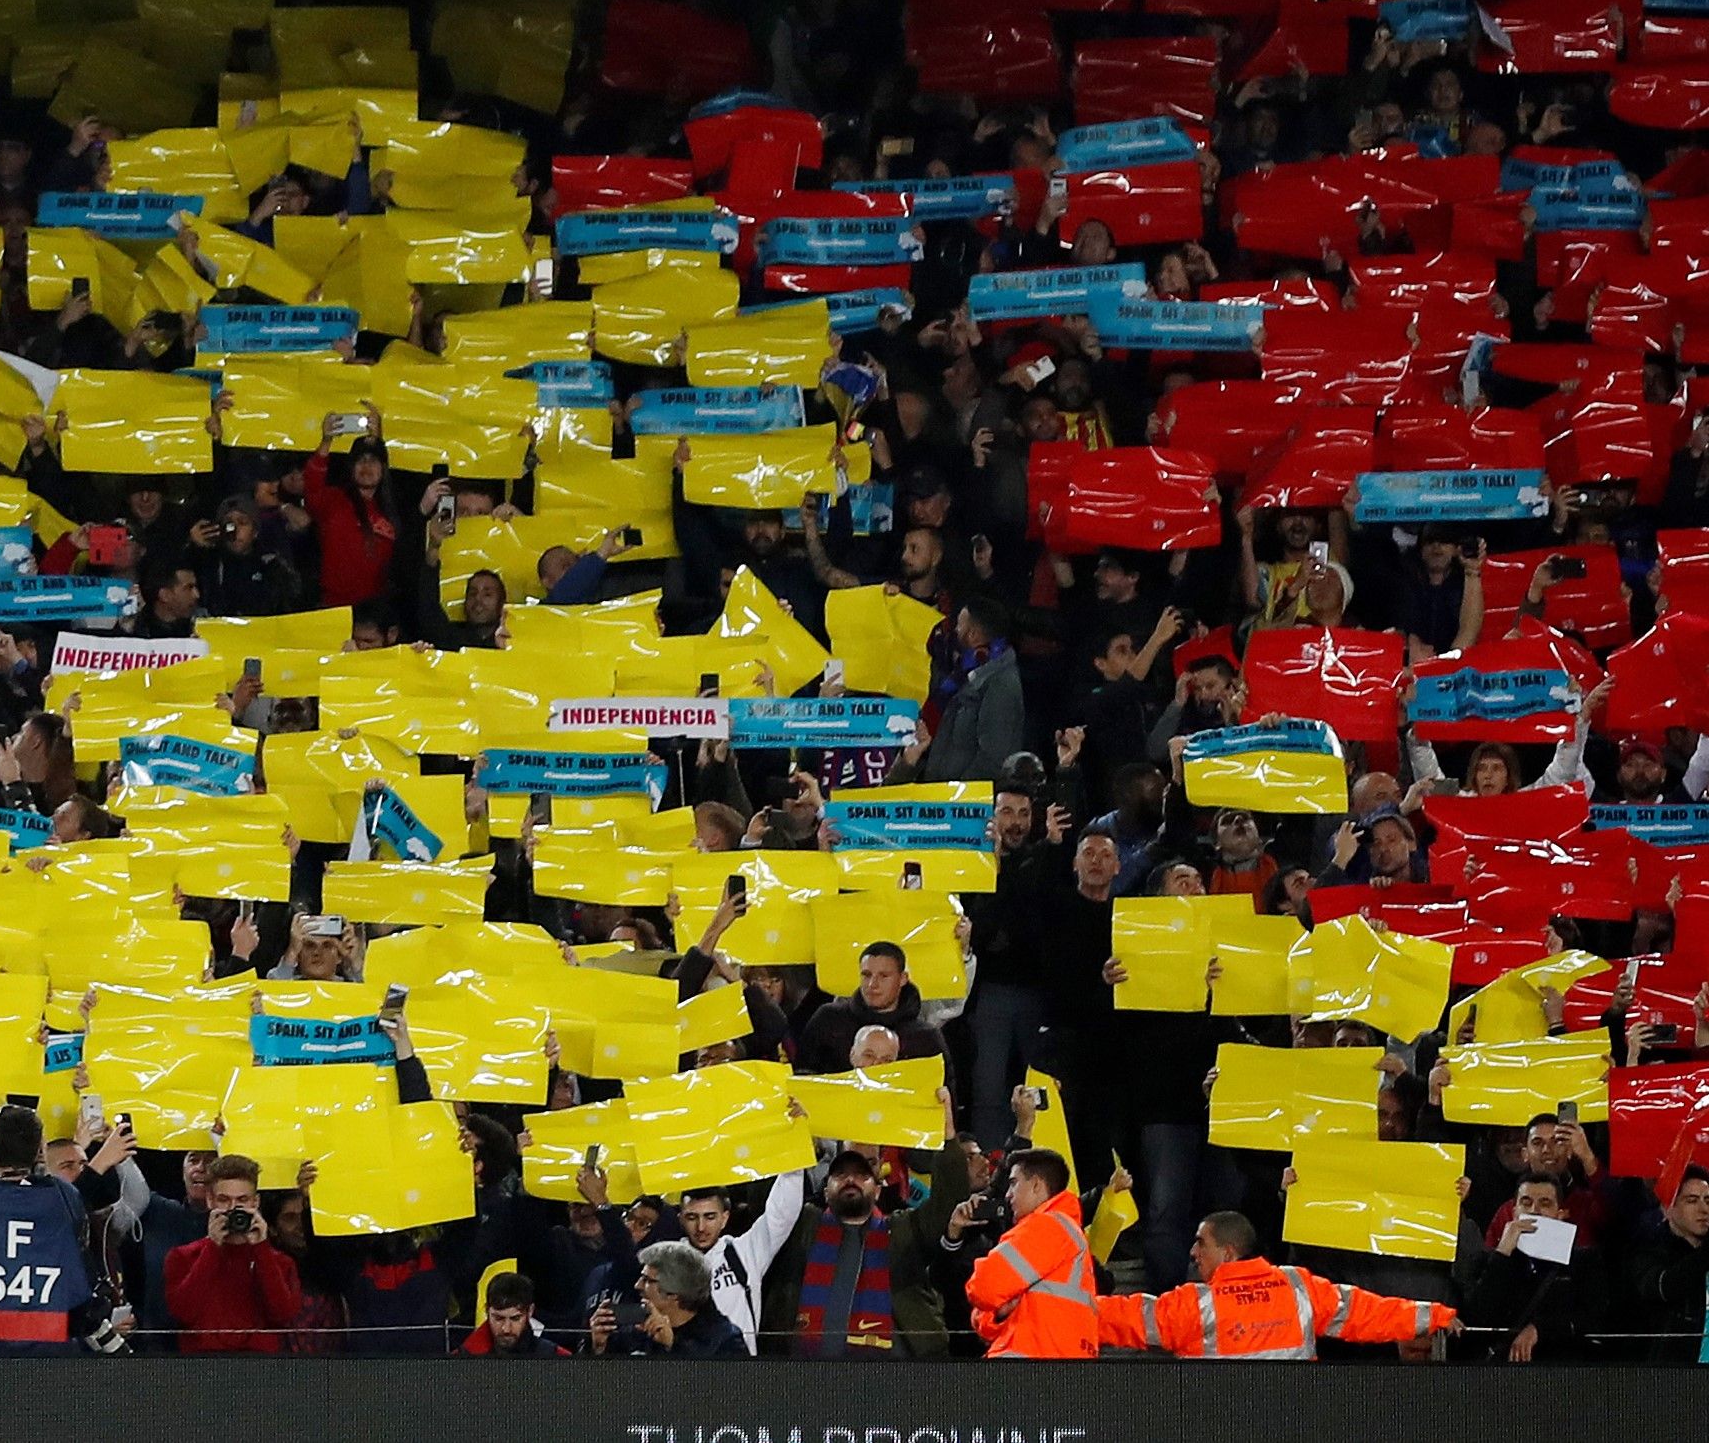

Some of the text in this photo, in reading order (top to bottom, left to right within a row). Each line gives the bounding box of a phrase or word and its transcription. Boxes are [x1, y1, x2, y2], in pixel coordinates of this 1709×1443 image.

[1454, 475, 1515, 488] AND TALK!
[563, 705, 718, 725] INDEPENDÈNCIA
[820, 704, 884, 716] AND TALK!
[556, 755, 575, 766] SIT
[579, 756, 605, 766] AND
[611, 756, 643, 767] TALK
[896, 808, 915, 819] SIT
[921, 808, 946, 819] AND
[952, 808, 986, 819] TALK!
[1637, 810, 1655, 821] SIT
[1661, 810, 1687, 821] AND
[315, 1026, 333, 1039] SIT
[339, 1025, 361, 1038] AND
[7, 1220, 35, 1258] F
